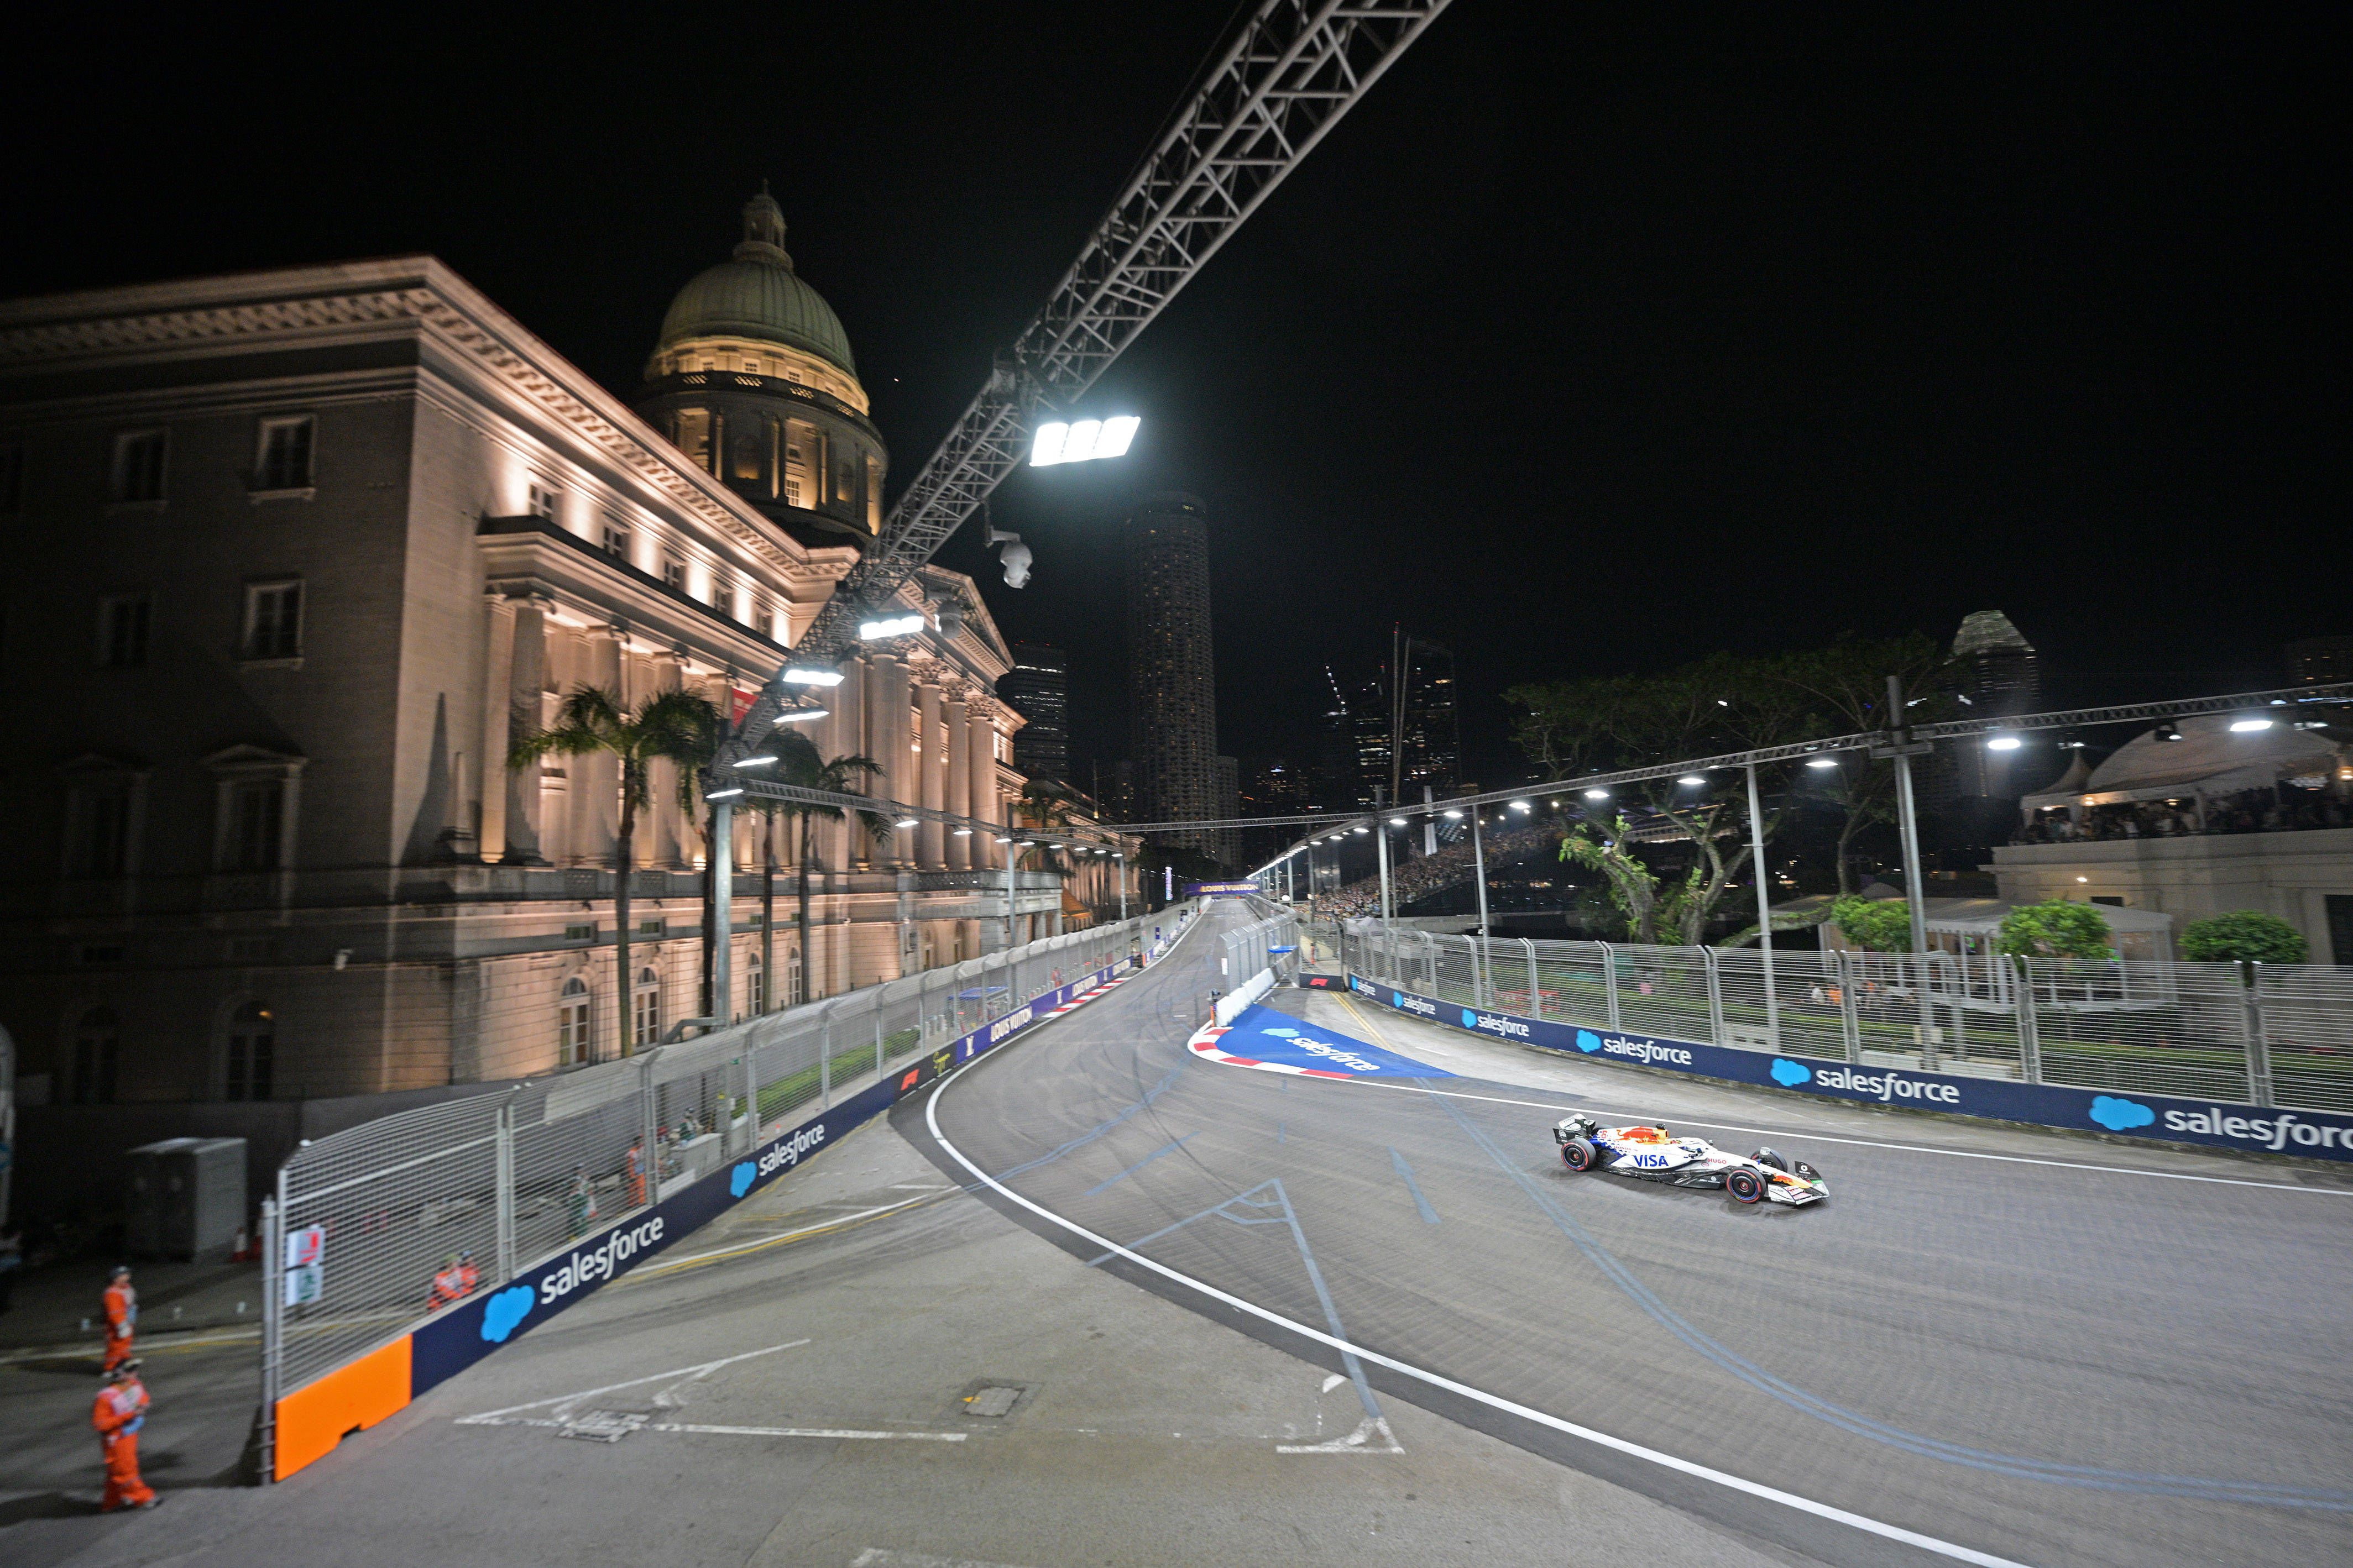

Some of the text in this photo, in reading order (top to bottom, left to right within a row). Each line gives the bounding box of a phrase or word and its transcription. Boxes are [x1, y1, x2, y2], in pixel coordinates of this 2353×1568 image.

[1403, 996, 1436, 1015] salesforce
[1477, 1014, 1530, 1037] salesforce
[1285, 1037, 1381, 1071] salesforce
[1603, 1036, 1692, 1065] salesforce
[1816, 1067, 1960, 1103] salesforce
[1601, 1130, 1608, 1139] 6
[759, 1124, 825, 1176] salesforce
[1634, 1155, 1669, 1167] VISA
[541, 1216, 663, 1305] salesforce
